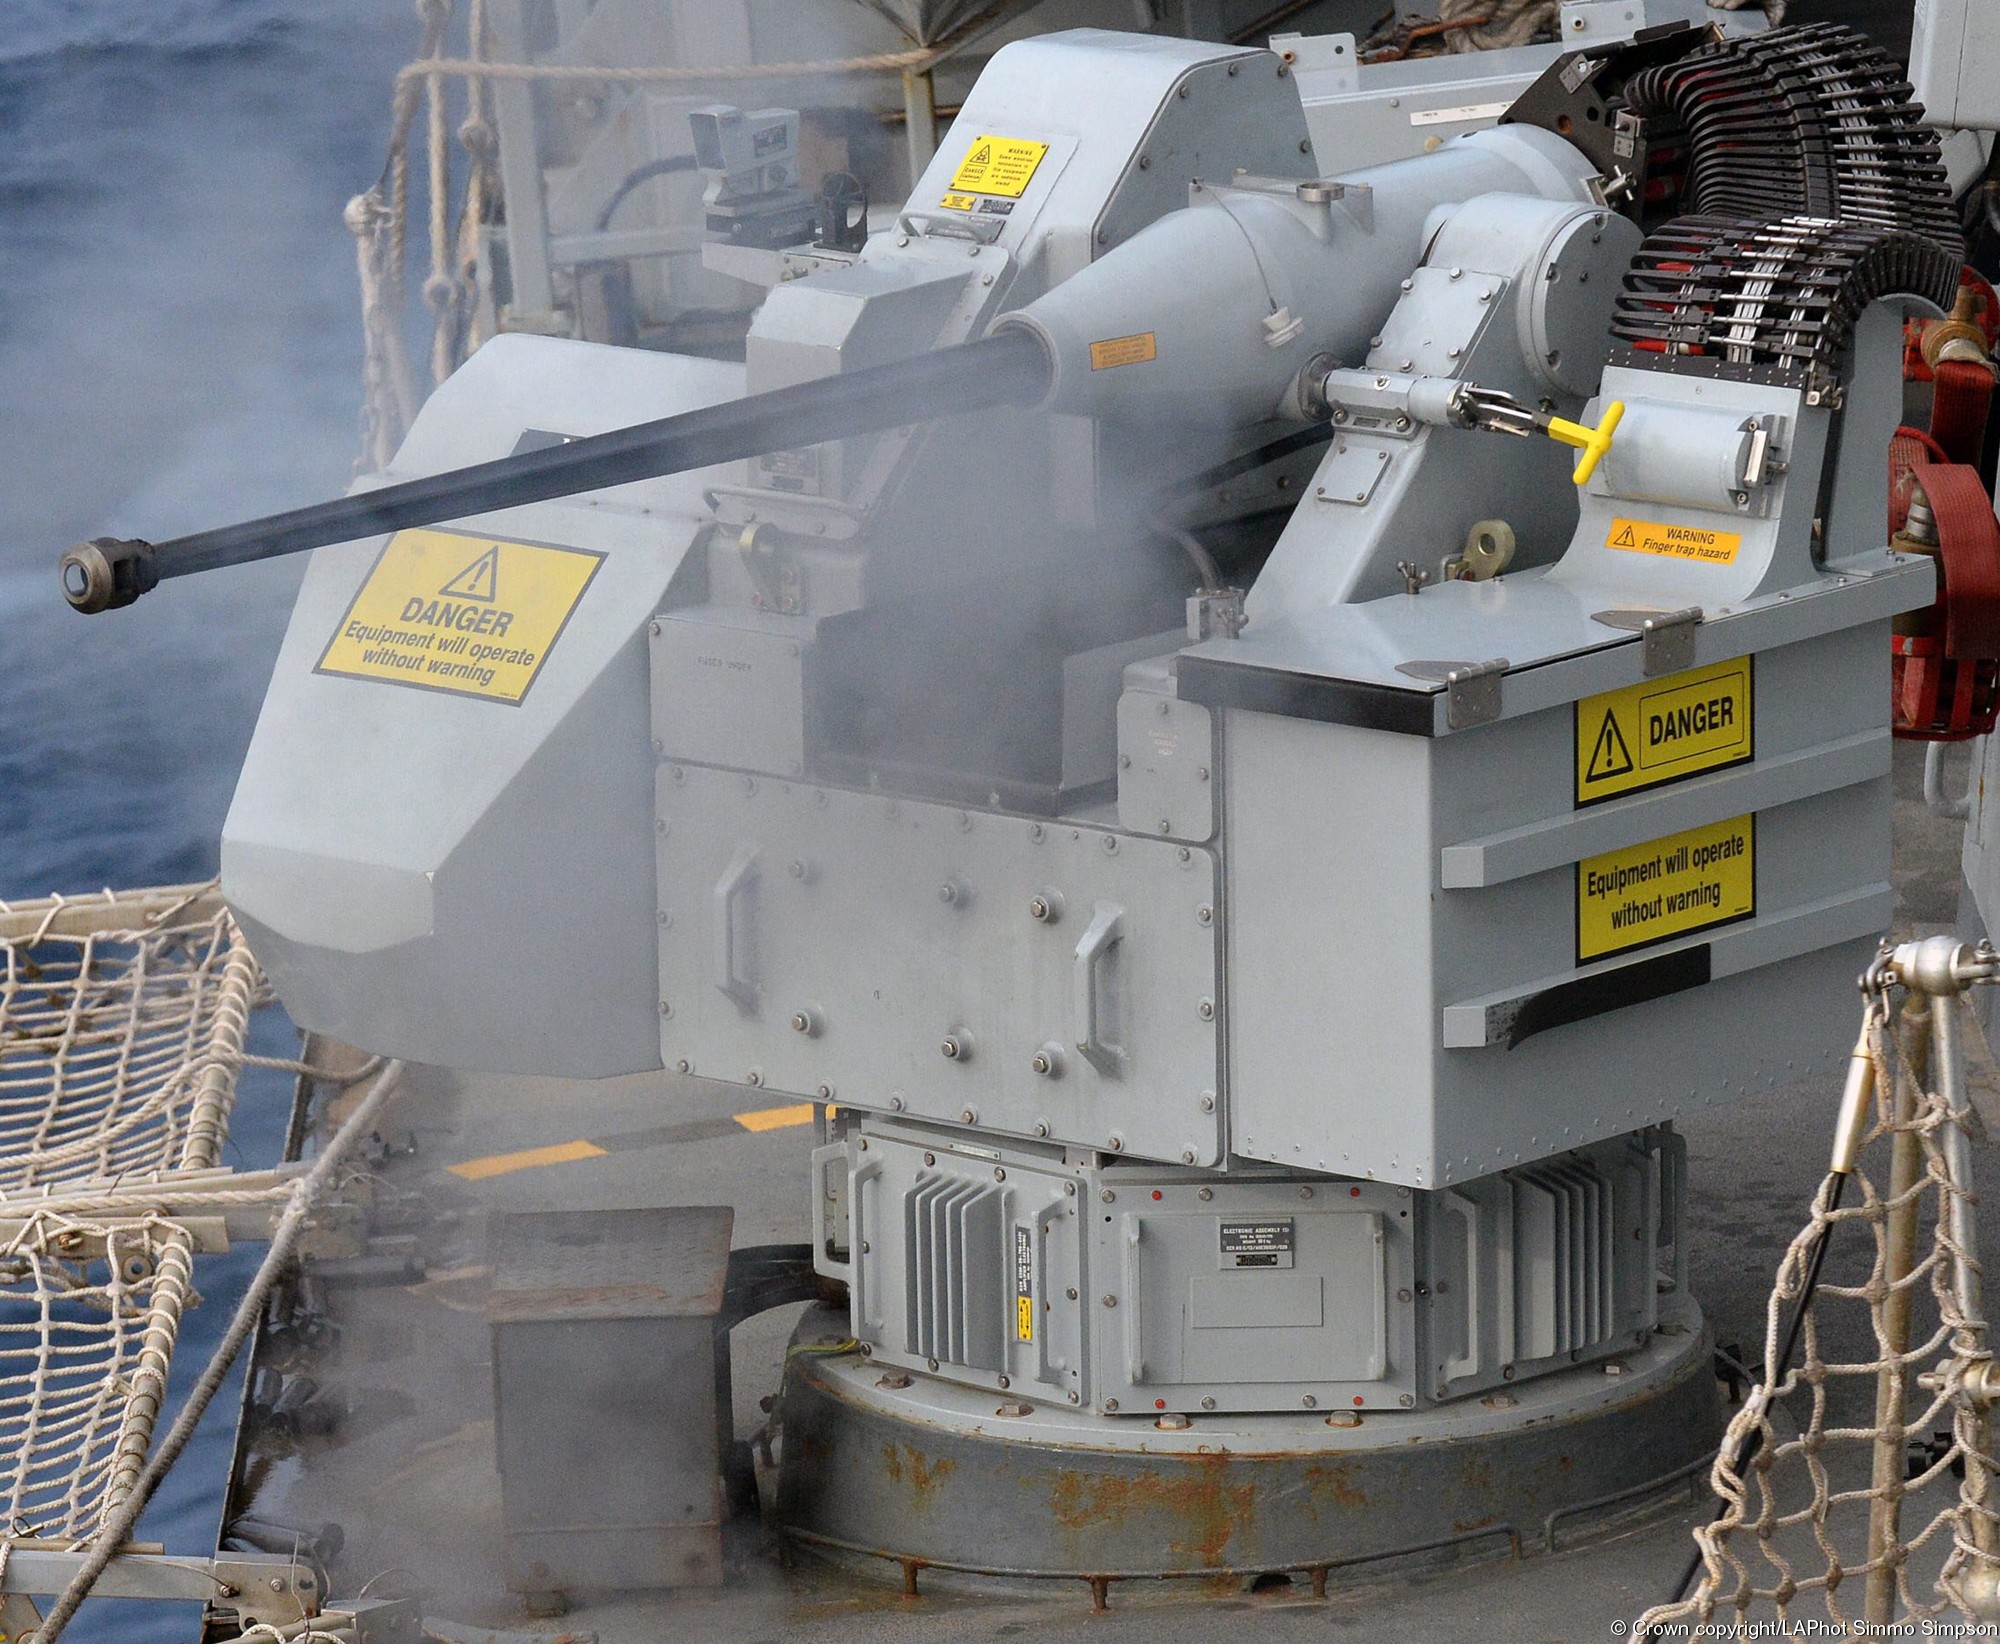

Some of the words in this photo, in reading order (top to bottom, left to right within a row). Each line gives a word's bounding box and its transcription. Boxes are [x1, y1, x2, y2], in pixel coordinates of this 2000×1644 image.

[1643, 538, 1675, 553] Finger
[1676, 545, 1696, 557] trap
[1697, 546, 1731, 560] hazard
[1667, 528, 1715, 544] WARNING
[399, 597, 514, 637] DANGER
[344, 620, 435, 651] Equipment
[437, 634, 468, 654] will
[469, 643, 535, 667] operate
[362, 648, 425, 672] without
[427, 657, 495, 687] warning
[1650, 695, 1734, 747] DANGER
[1587, 853, 1662, 899] Equipment
[1665, 846, 1689, 875] will
[1692, 834, 1744, 871] operate
[1611, 894, 1662, 930] without
[1666, 881, 1721, 914] warning
